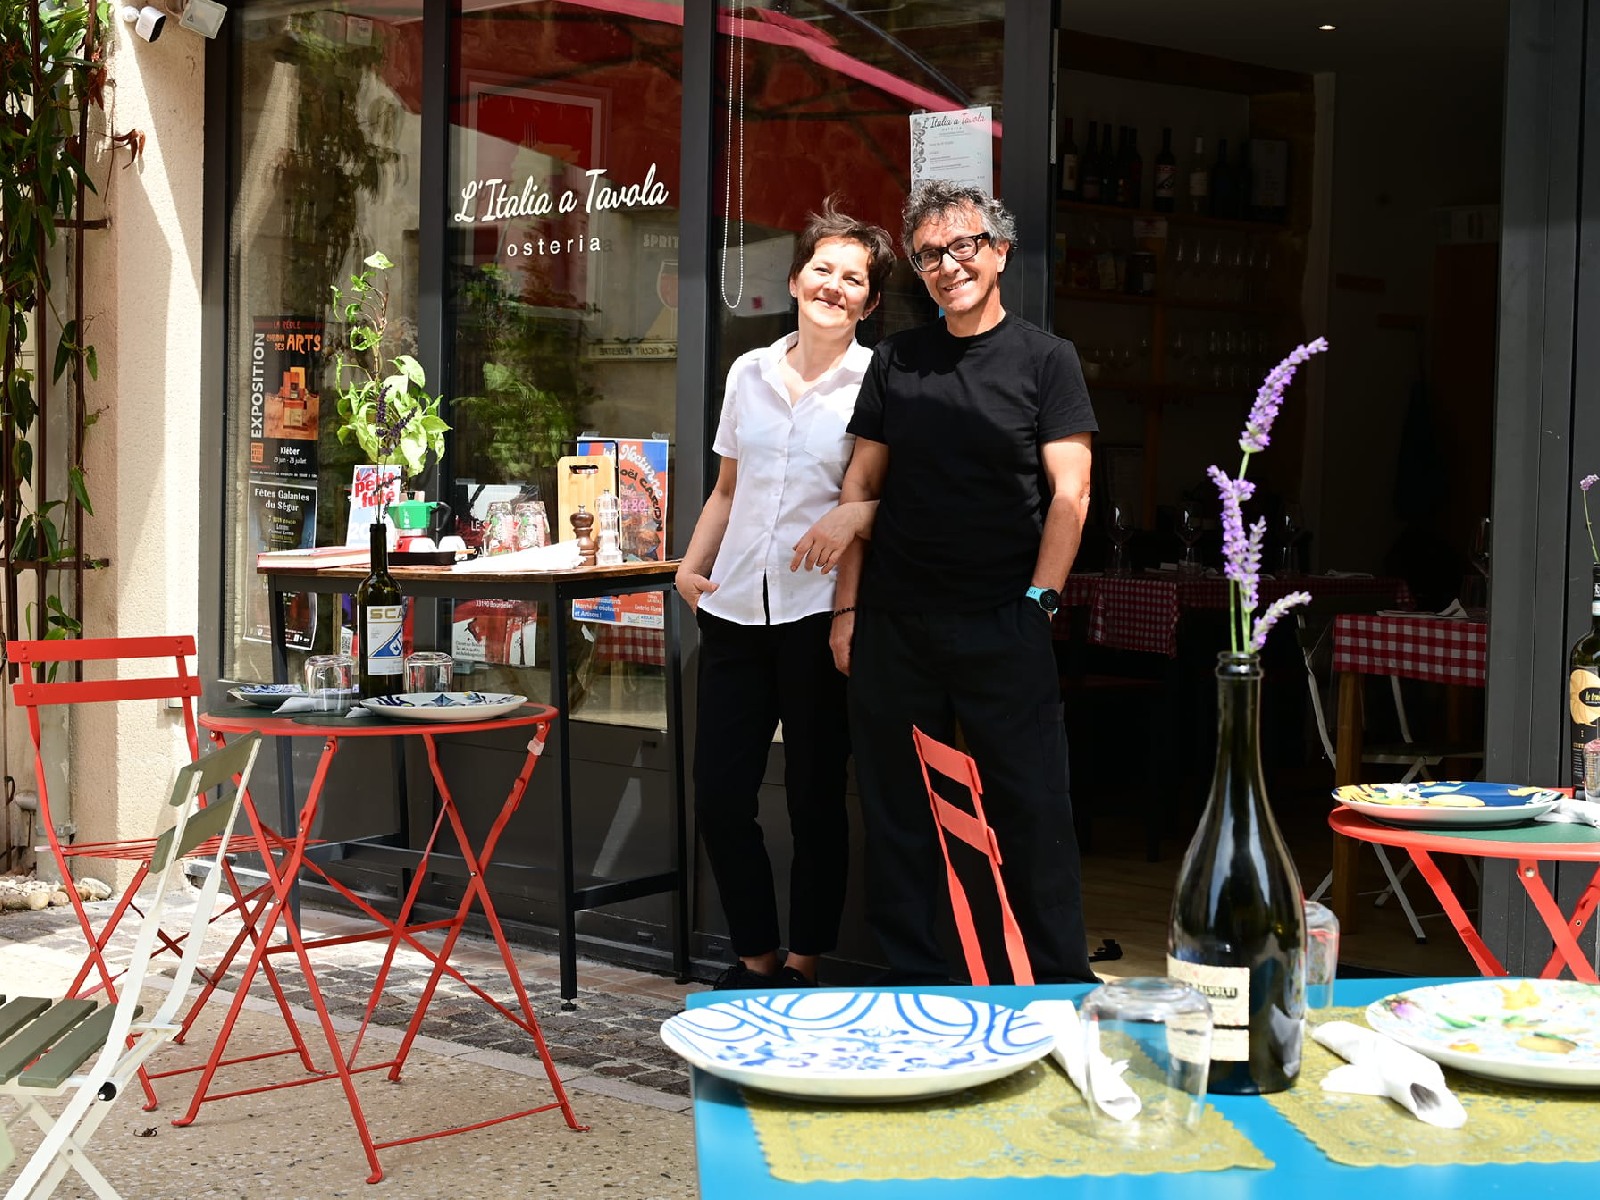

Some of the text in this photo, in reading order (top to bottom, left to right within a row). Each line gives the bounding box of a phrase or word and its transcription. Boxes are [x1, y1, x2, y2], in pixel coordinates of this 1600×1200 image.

[454, 162, 670, 223] L'Italia a Tavola
[507, 234, 601, 257] osteria
[286, 334, 321, 355] ARTS
[250, 333, 265, 438] EXPOSITION
[620, 468, 639, 481] oël
[265, 499, 276, 509] du
[277, 489, 310, 502] Galantes
